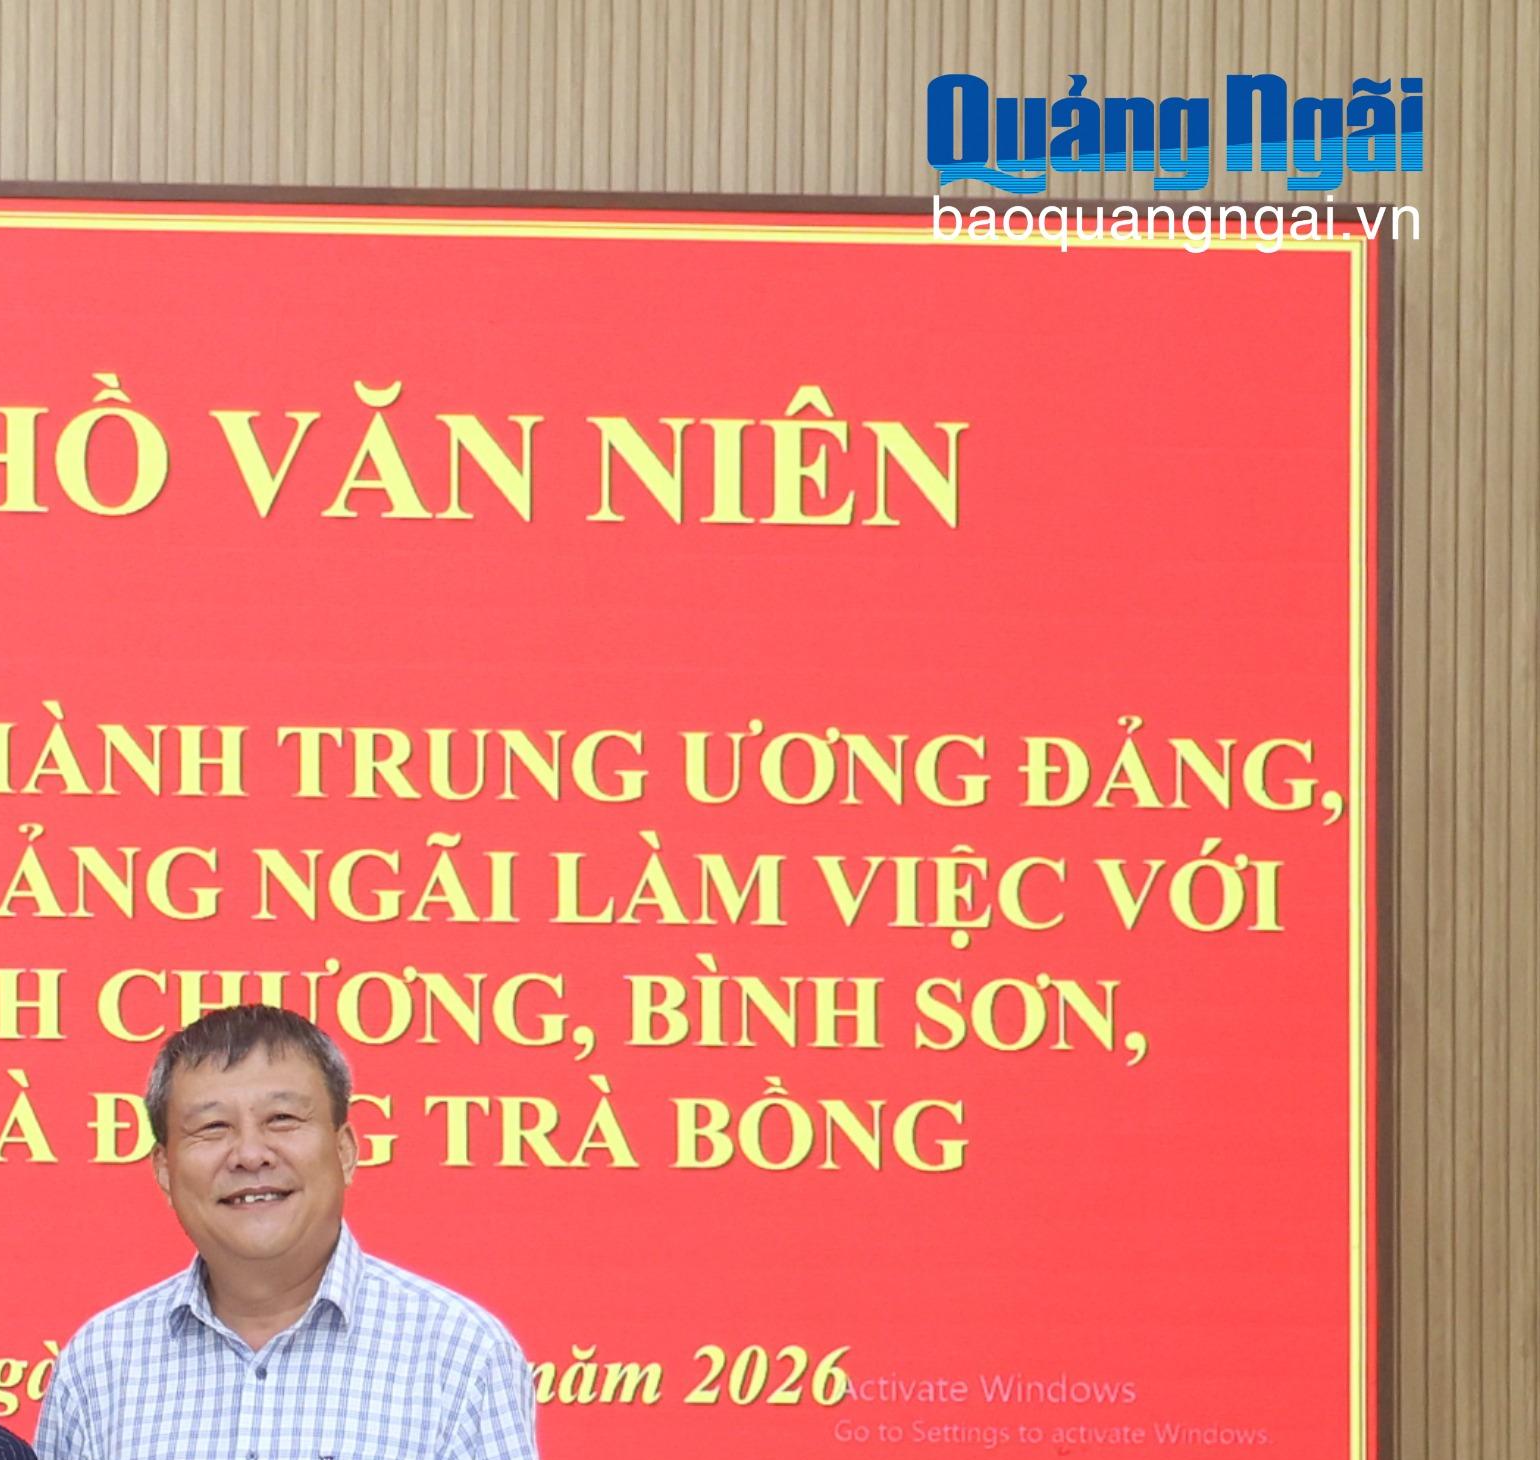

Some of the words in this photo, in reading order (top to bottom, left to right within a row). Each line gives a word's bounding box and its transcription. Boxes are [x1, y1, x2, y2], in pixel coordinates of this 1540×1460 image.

[208, 379, 545, 522] VĂN
[587, 384, 970, 527] NIÊN
[276, 725, 649, 803] TRUNG
[680, 718, 992, 808] ƯƠNG
[1017, 714, 1344, 826] ĐẢNG,
[252, 830, 518, 924] NGÃI
[552, 830, 788, 928] LÀM
[813, 844, 1068, 950] VIỆC
[1094, 838, 1286, 933] VỚI
[623, 952, 885, 1050] BÌNH
[913, 972, 1148, 1066] SƠN,
[86, 1091, 399, 1168] ĐG
[423, 1073, 641, 1169] TRÀ
[670, 1075, 970, 1173] BỒNG
[528, 1345, 663, 1405] năm
[683, 1345, 851, 1406] 2026
[842, 1374, 969, 1402] Activate
[979, 1373, 1137, 1404] Windows
[833, 1420, 870, 1444] Go
[878, 1421, 904, 1444] to
[912, 1419, 1010, 1450] Settings
[1018, 1422, 1044, 1445] to
[1051, 1421, 1146, 1446] activate
